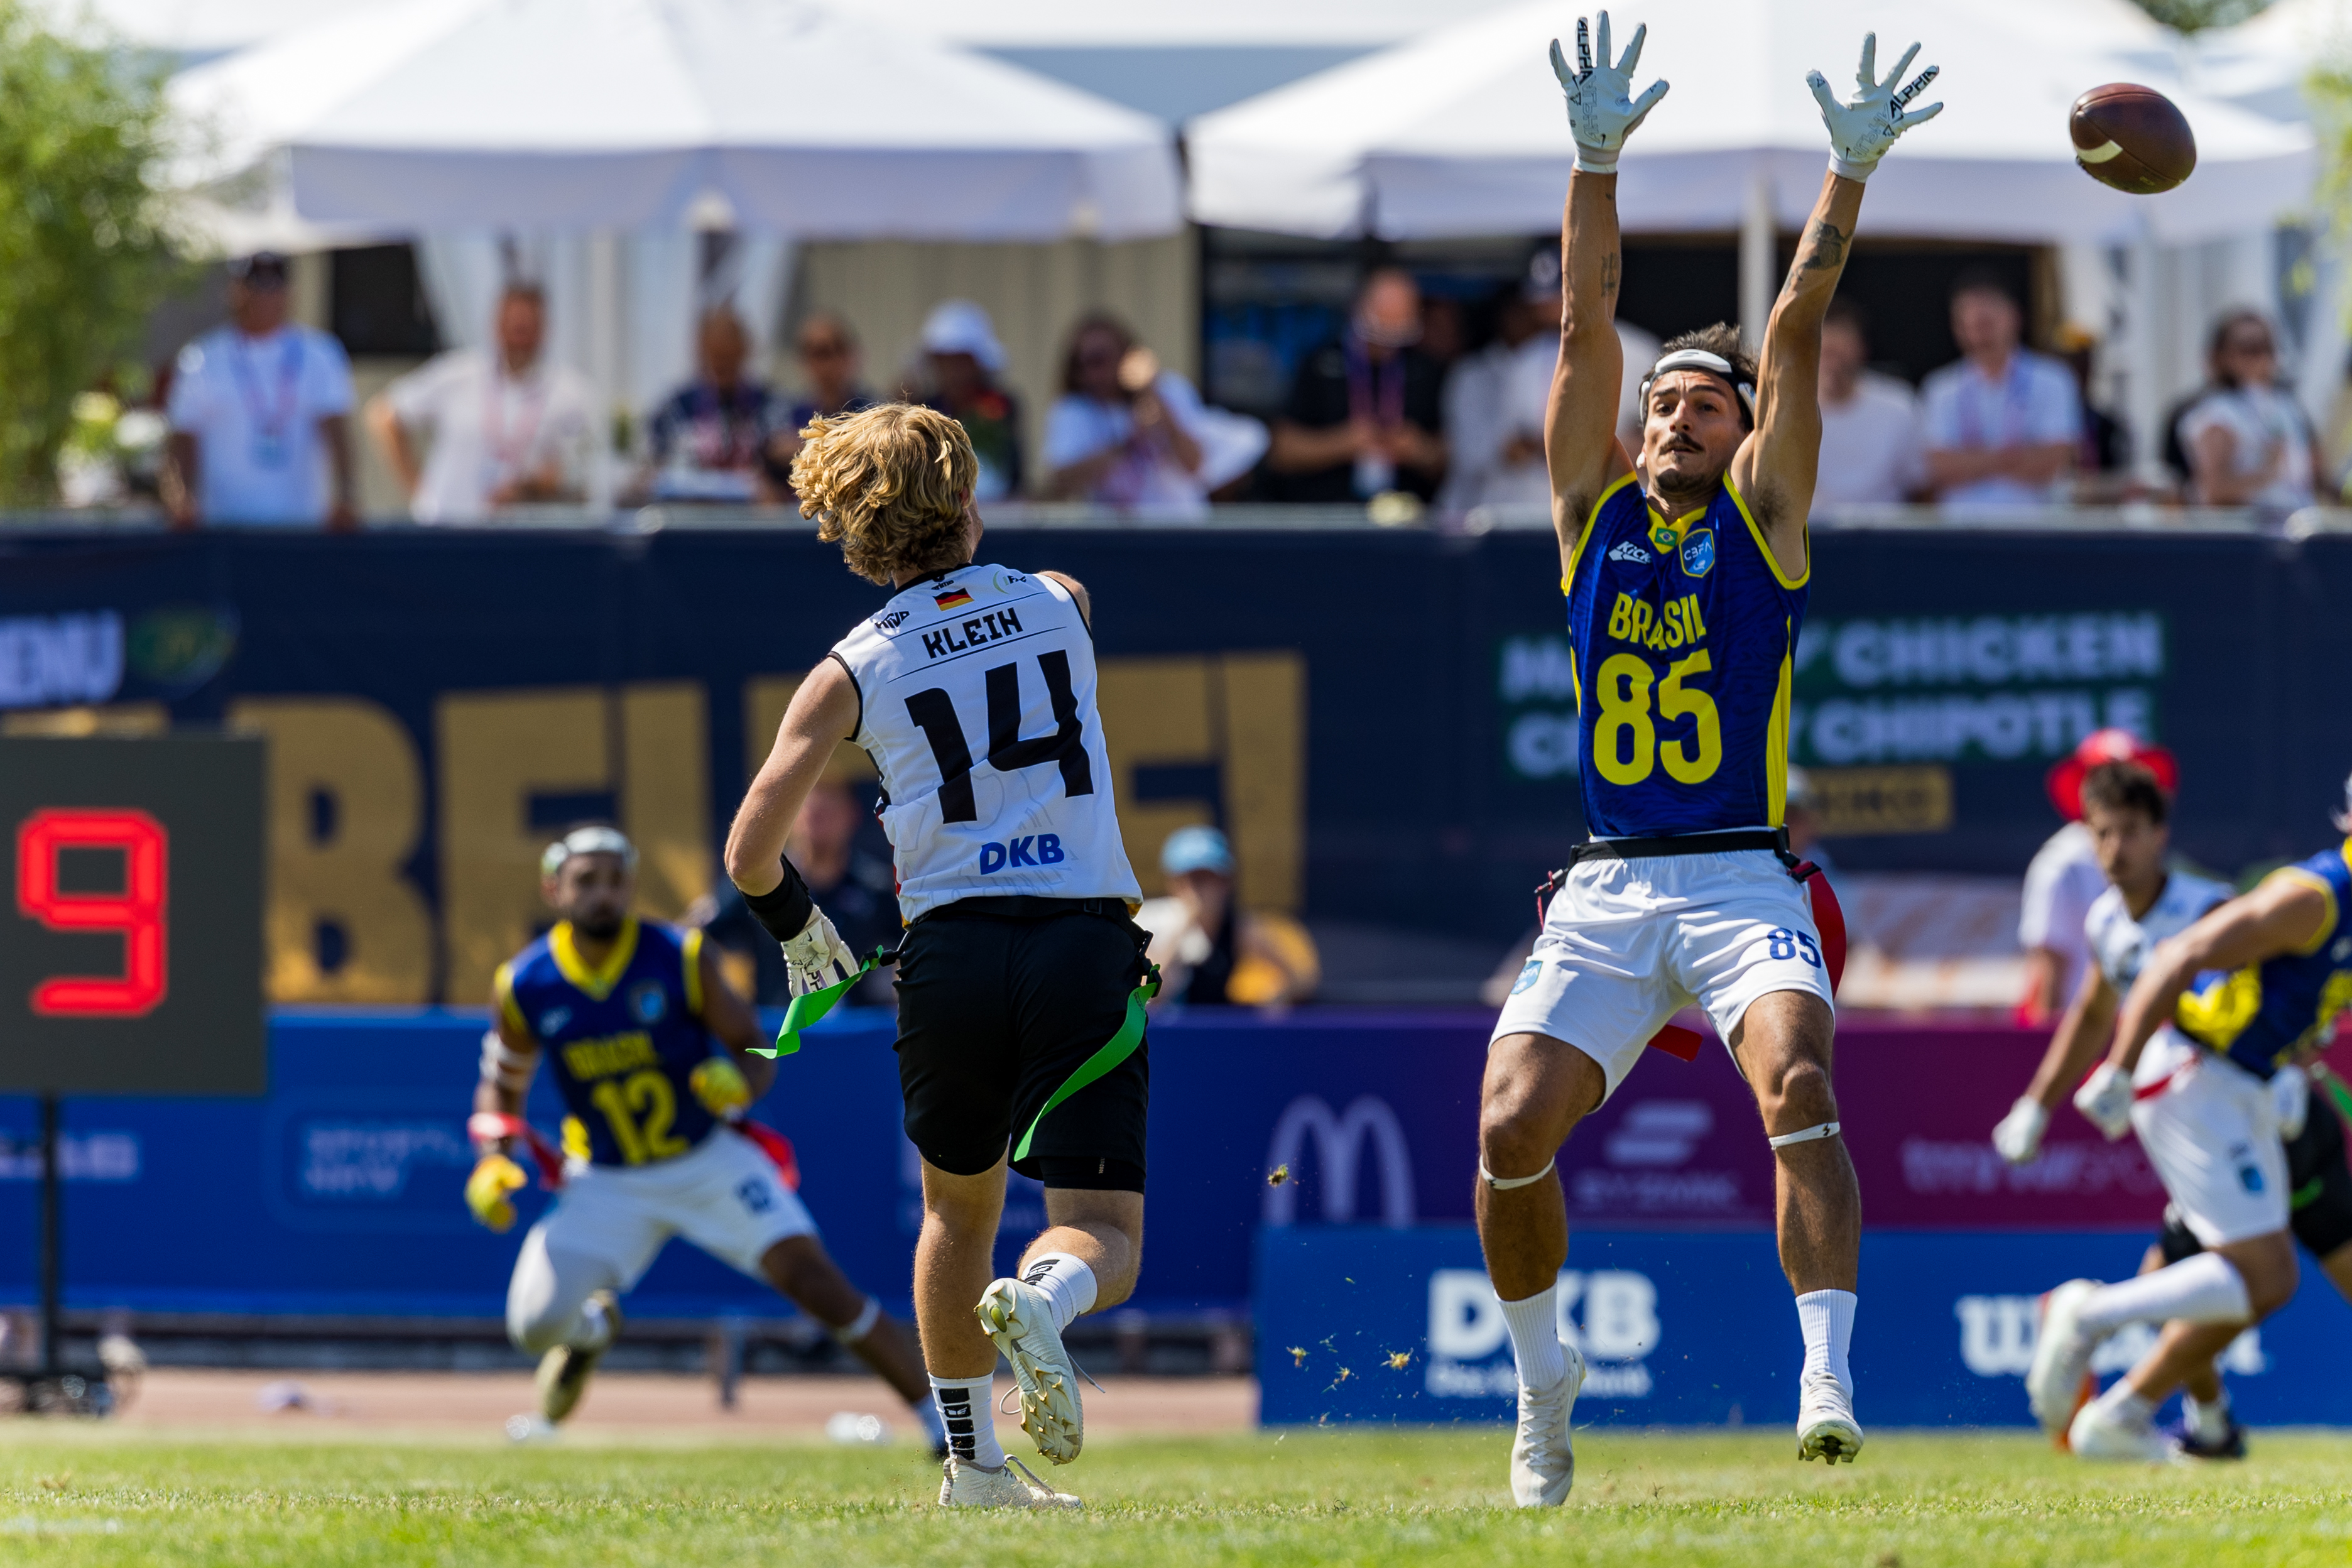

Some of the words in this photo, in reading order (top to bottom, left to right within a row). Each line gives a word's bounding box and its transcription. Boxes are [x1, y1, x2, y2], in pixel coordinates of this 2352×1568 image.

[1890, 70, 1937, 119] ALPHA
[922, 607, 1023, 659] KLEIN
[1608, 591, 1707, 651] BRASIL
[1833, 611, 2164, 687] CHICKEN
[904, 649, 1094, 824] 14
[1594, 648, 1722, 785] 85
[1809, 691, 2153, 763] CHIPOTLE
[979, 833, 1065, 874] DKB
[17, 807, 170, 1018] 9
[1767, 927, 1822, 969] 85
[592, 1069, 689, 1167] 12
